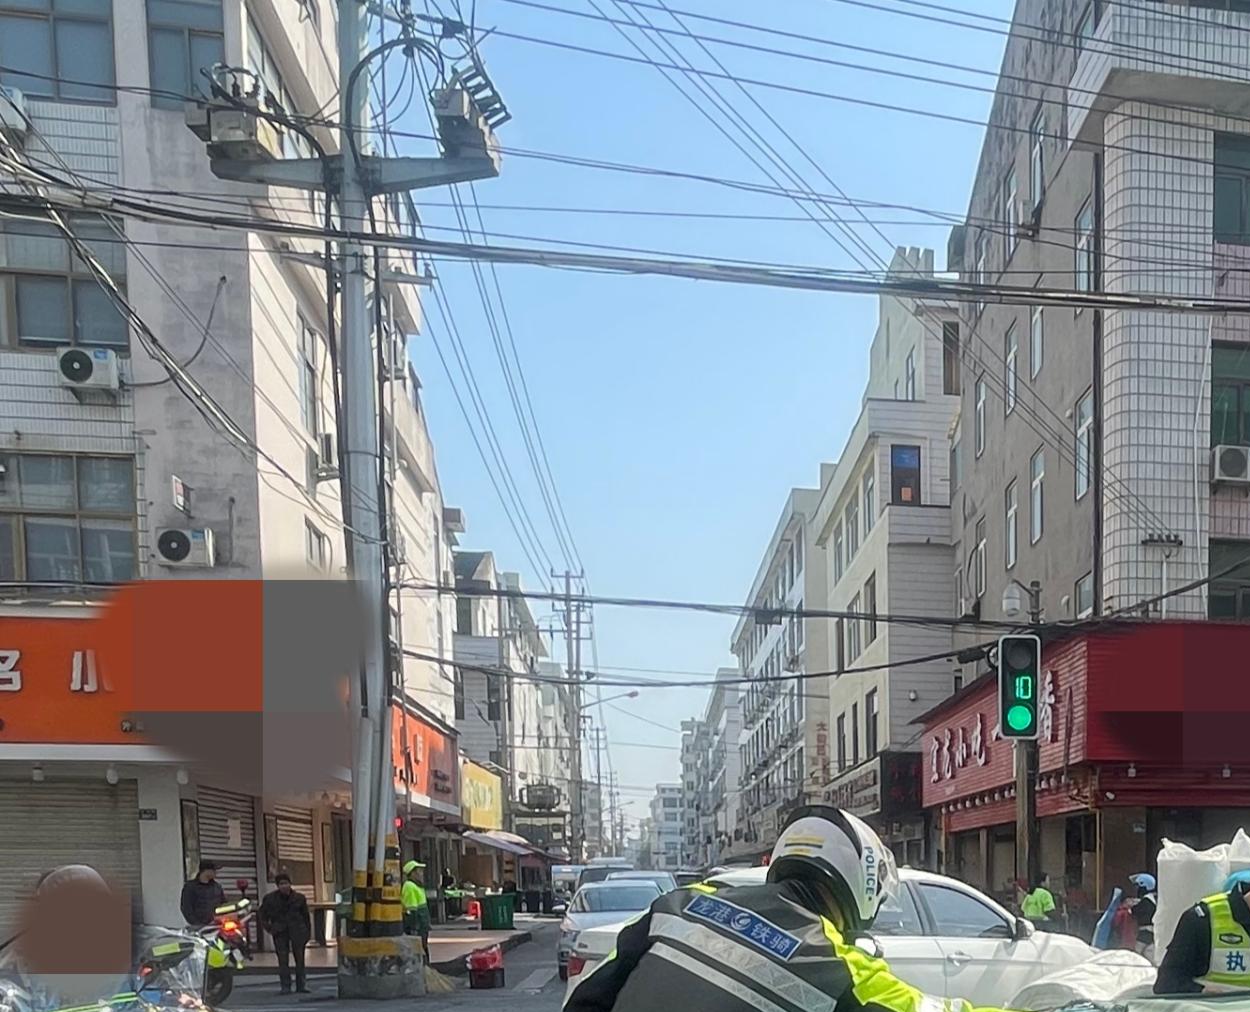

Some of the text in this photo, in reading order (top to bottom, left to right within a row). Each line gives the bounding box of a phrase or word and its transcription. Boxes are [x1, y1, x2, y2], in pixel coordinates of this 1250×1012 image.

[1015, 675, 1032, 700] 10
[864, 846, 876, 896] POLICE
[693, 899, 792, 954] 龙港 铁骑
